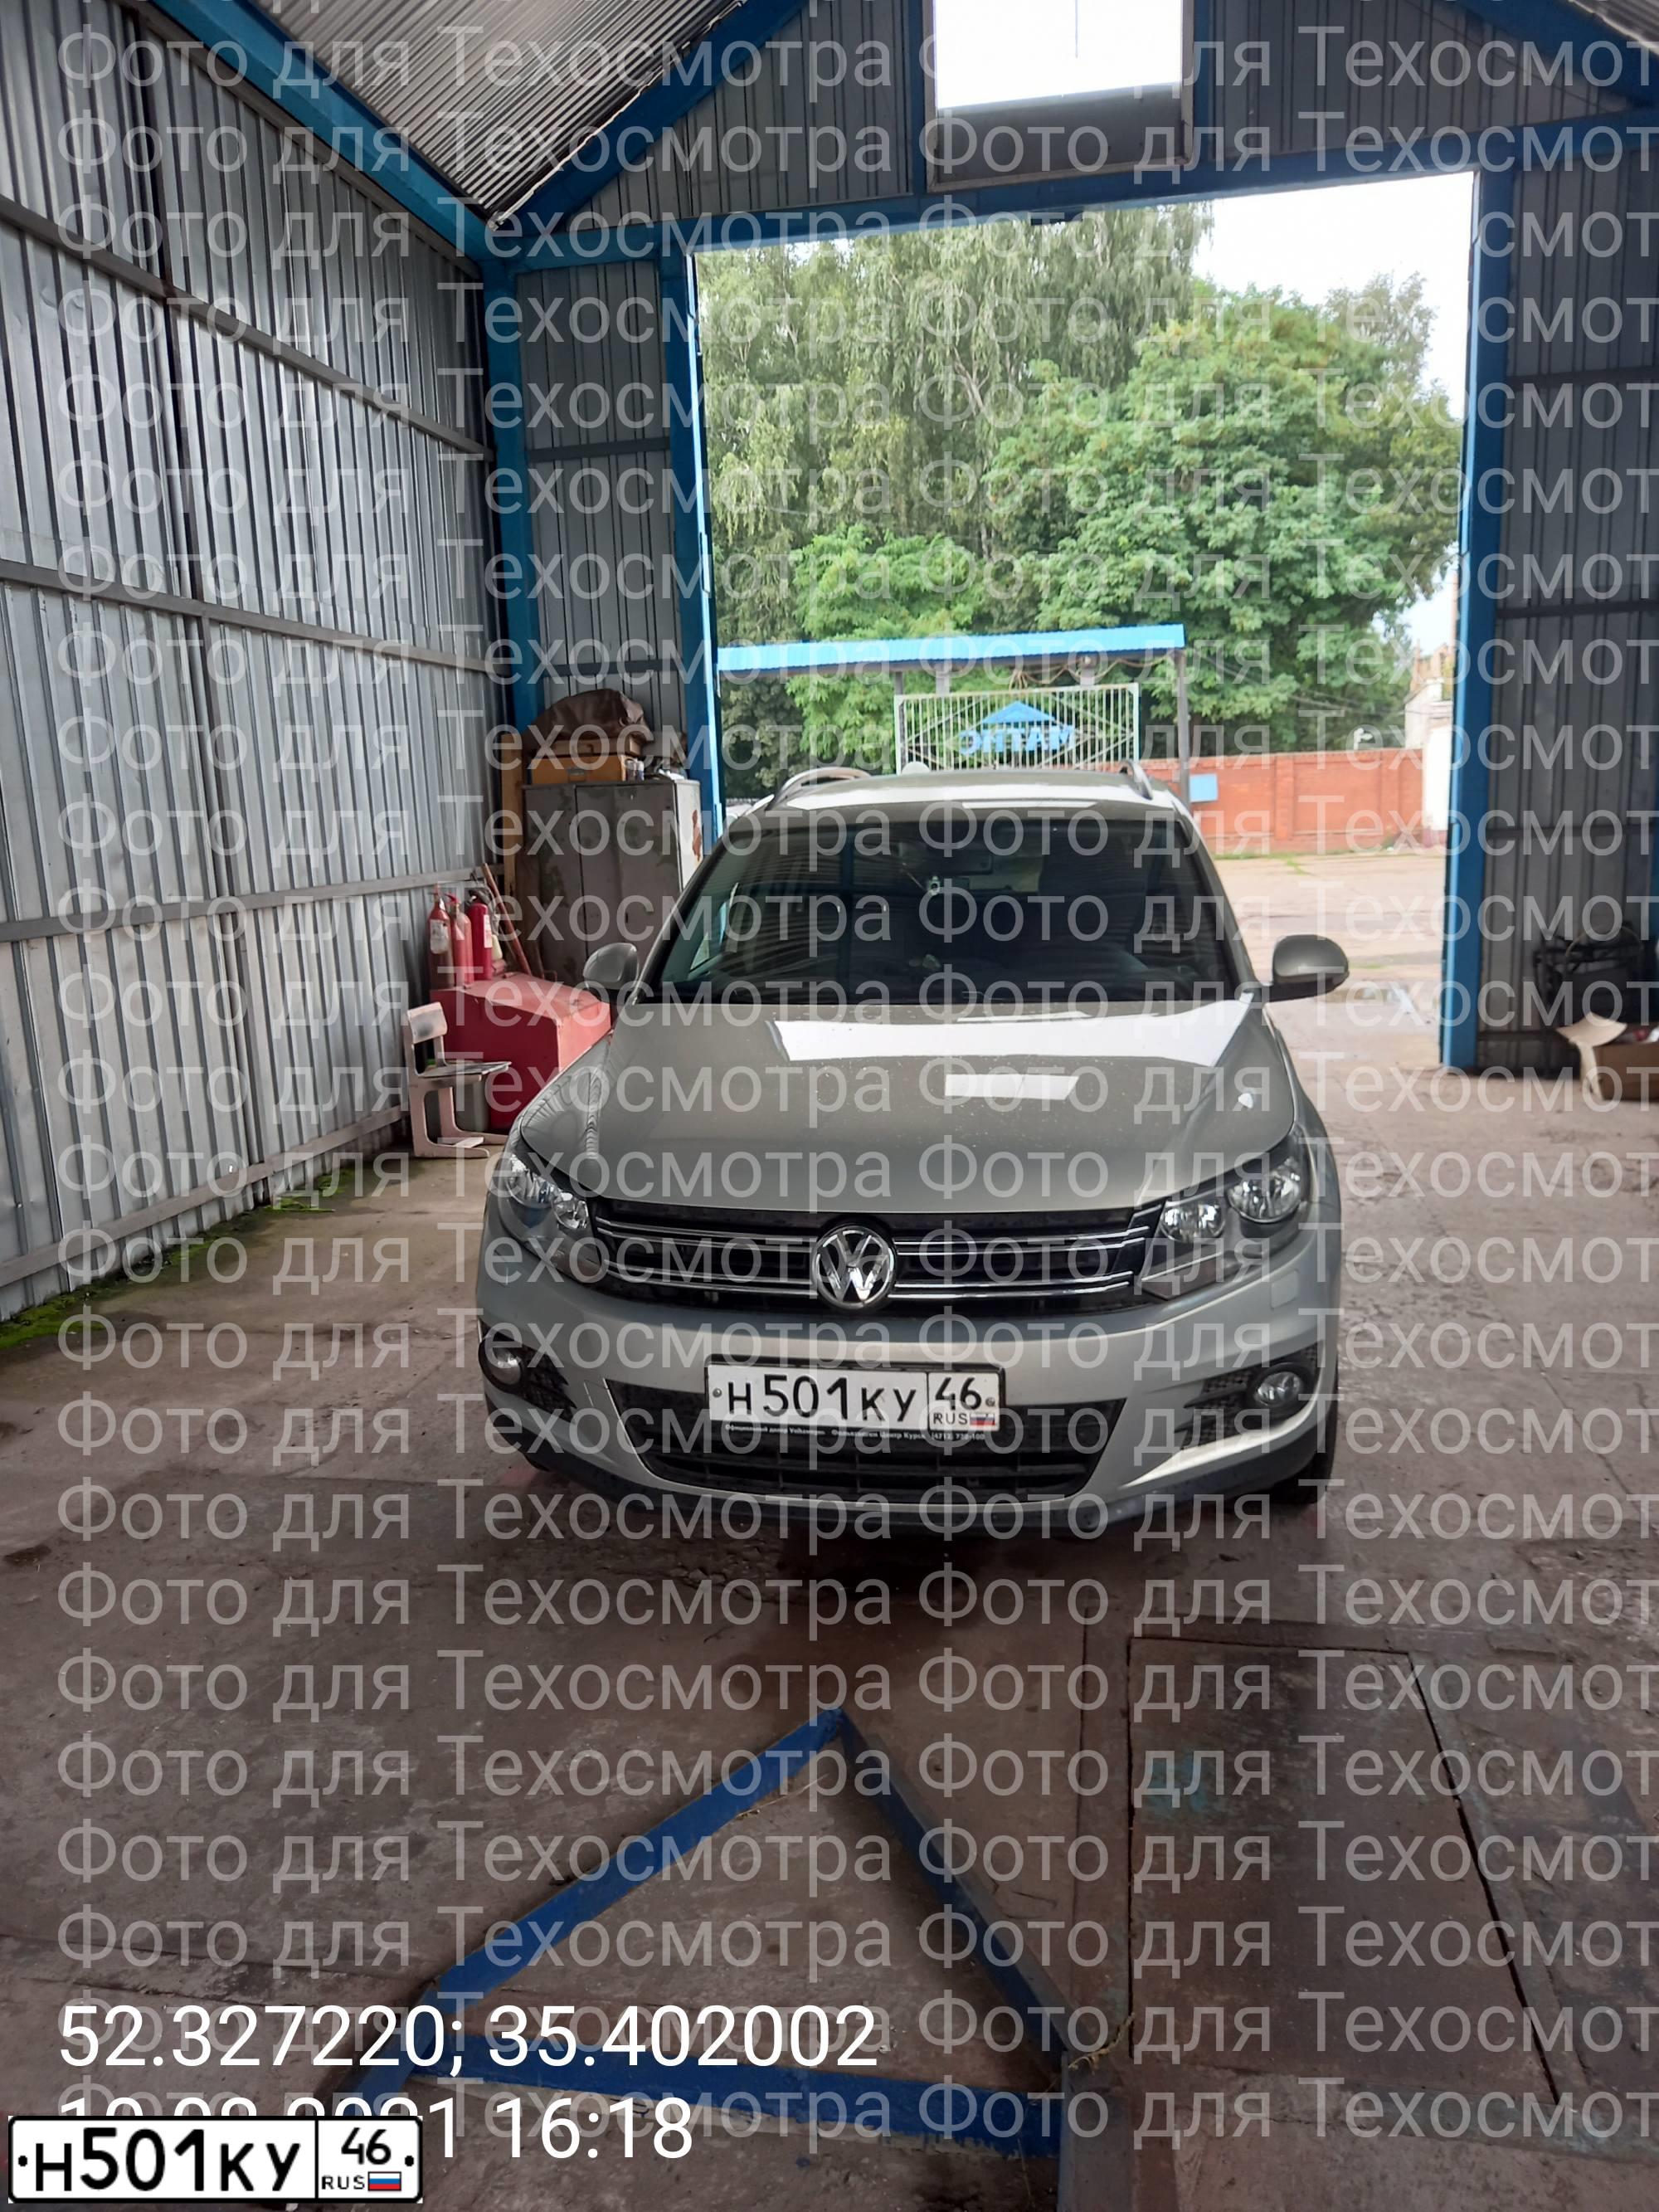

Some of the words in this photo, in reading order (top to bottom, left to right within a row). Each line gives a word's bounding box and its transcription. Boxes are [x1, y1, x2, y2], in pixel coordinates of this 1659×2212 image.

[728, 1374, 917, 1421] Н501КУ
[935, 1377, 981, 1411] 46
[933, 1411, 968, 1425] RUS
